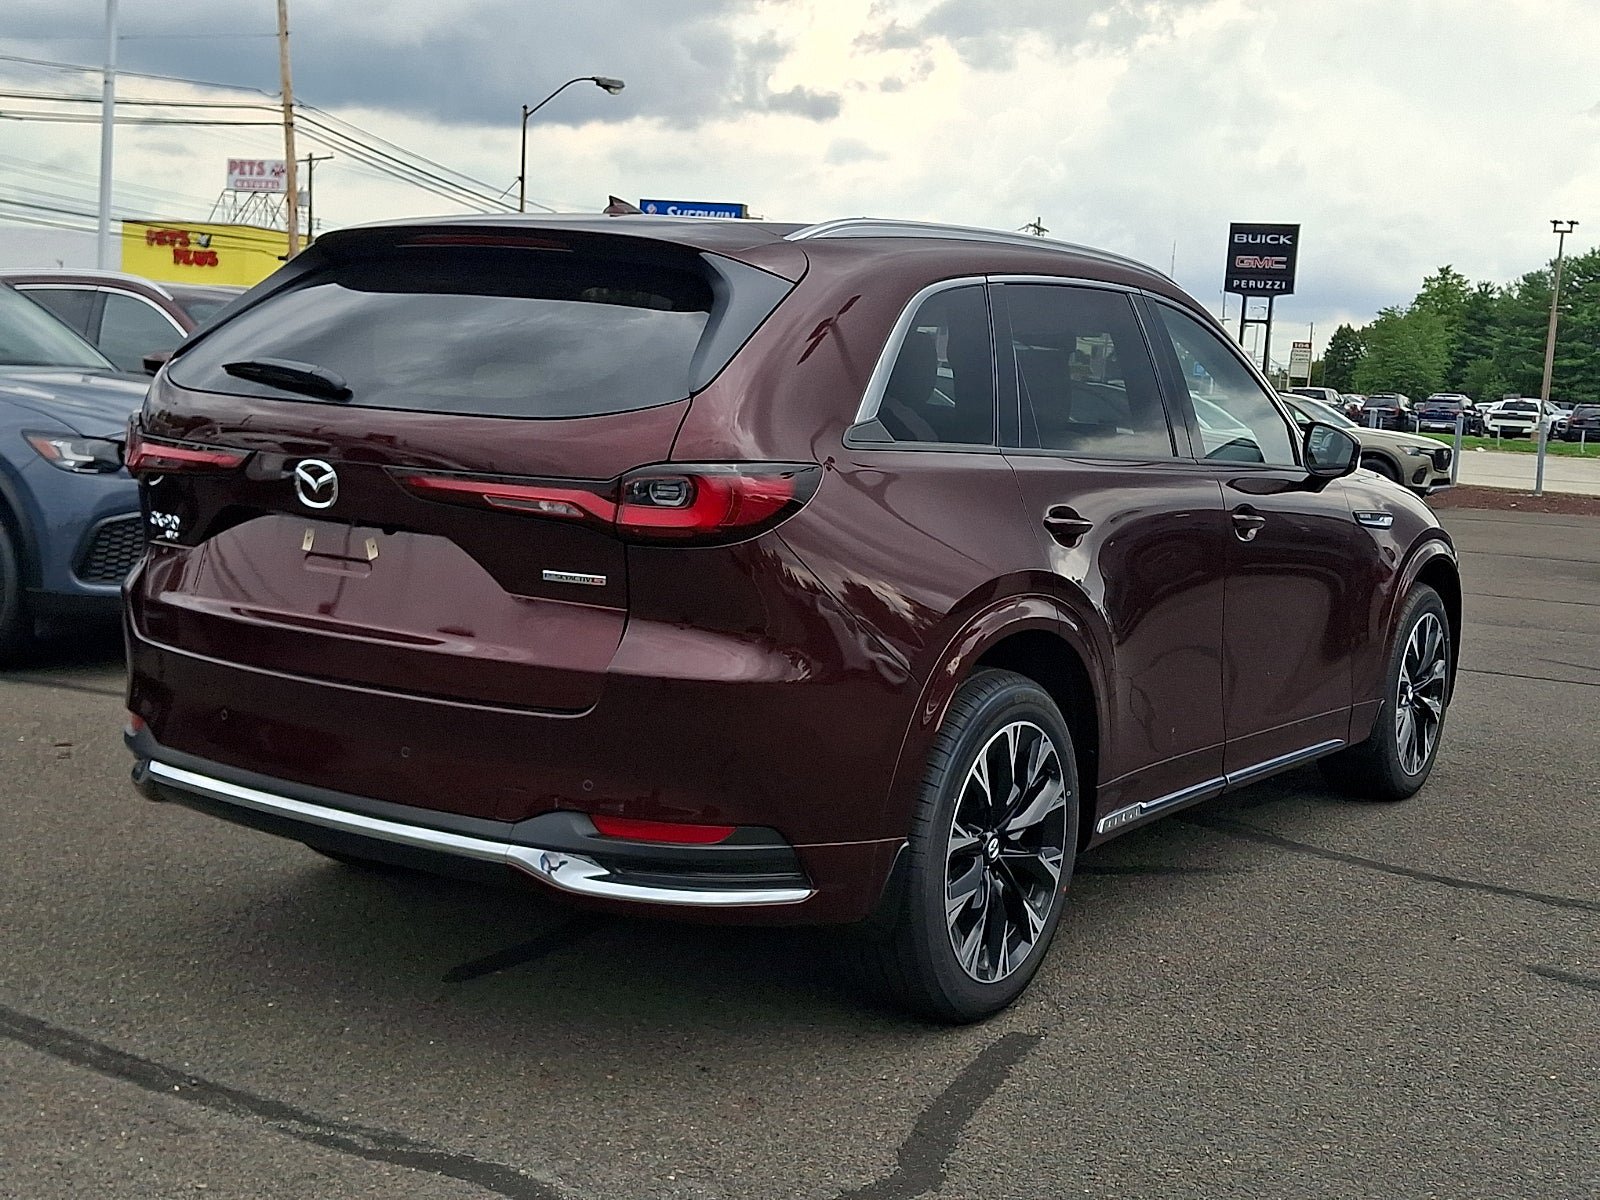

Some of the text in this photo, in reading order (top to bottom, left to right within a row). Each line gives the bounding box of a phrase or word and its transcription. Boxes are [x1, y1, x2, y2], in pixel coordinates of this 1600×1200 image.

[1234, 233, 1293, 245] BUICK
[173, 248, 218, 267] PLUS
[1235, 255, 1288, 269] GMC
[1233, 280, 1286, 289] PERUZZI
